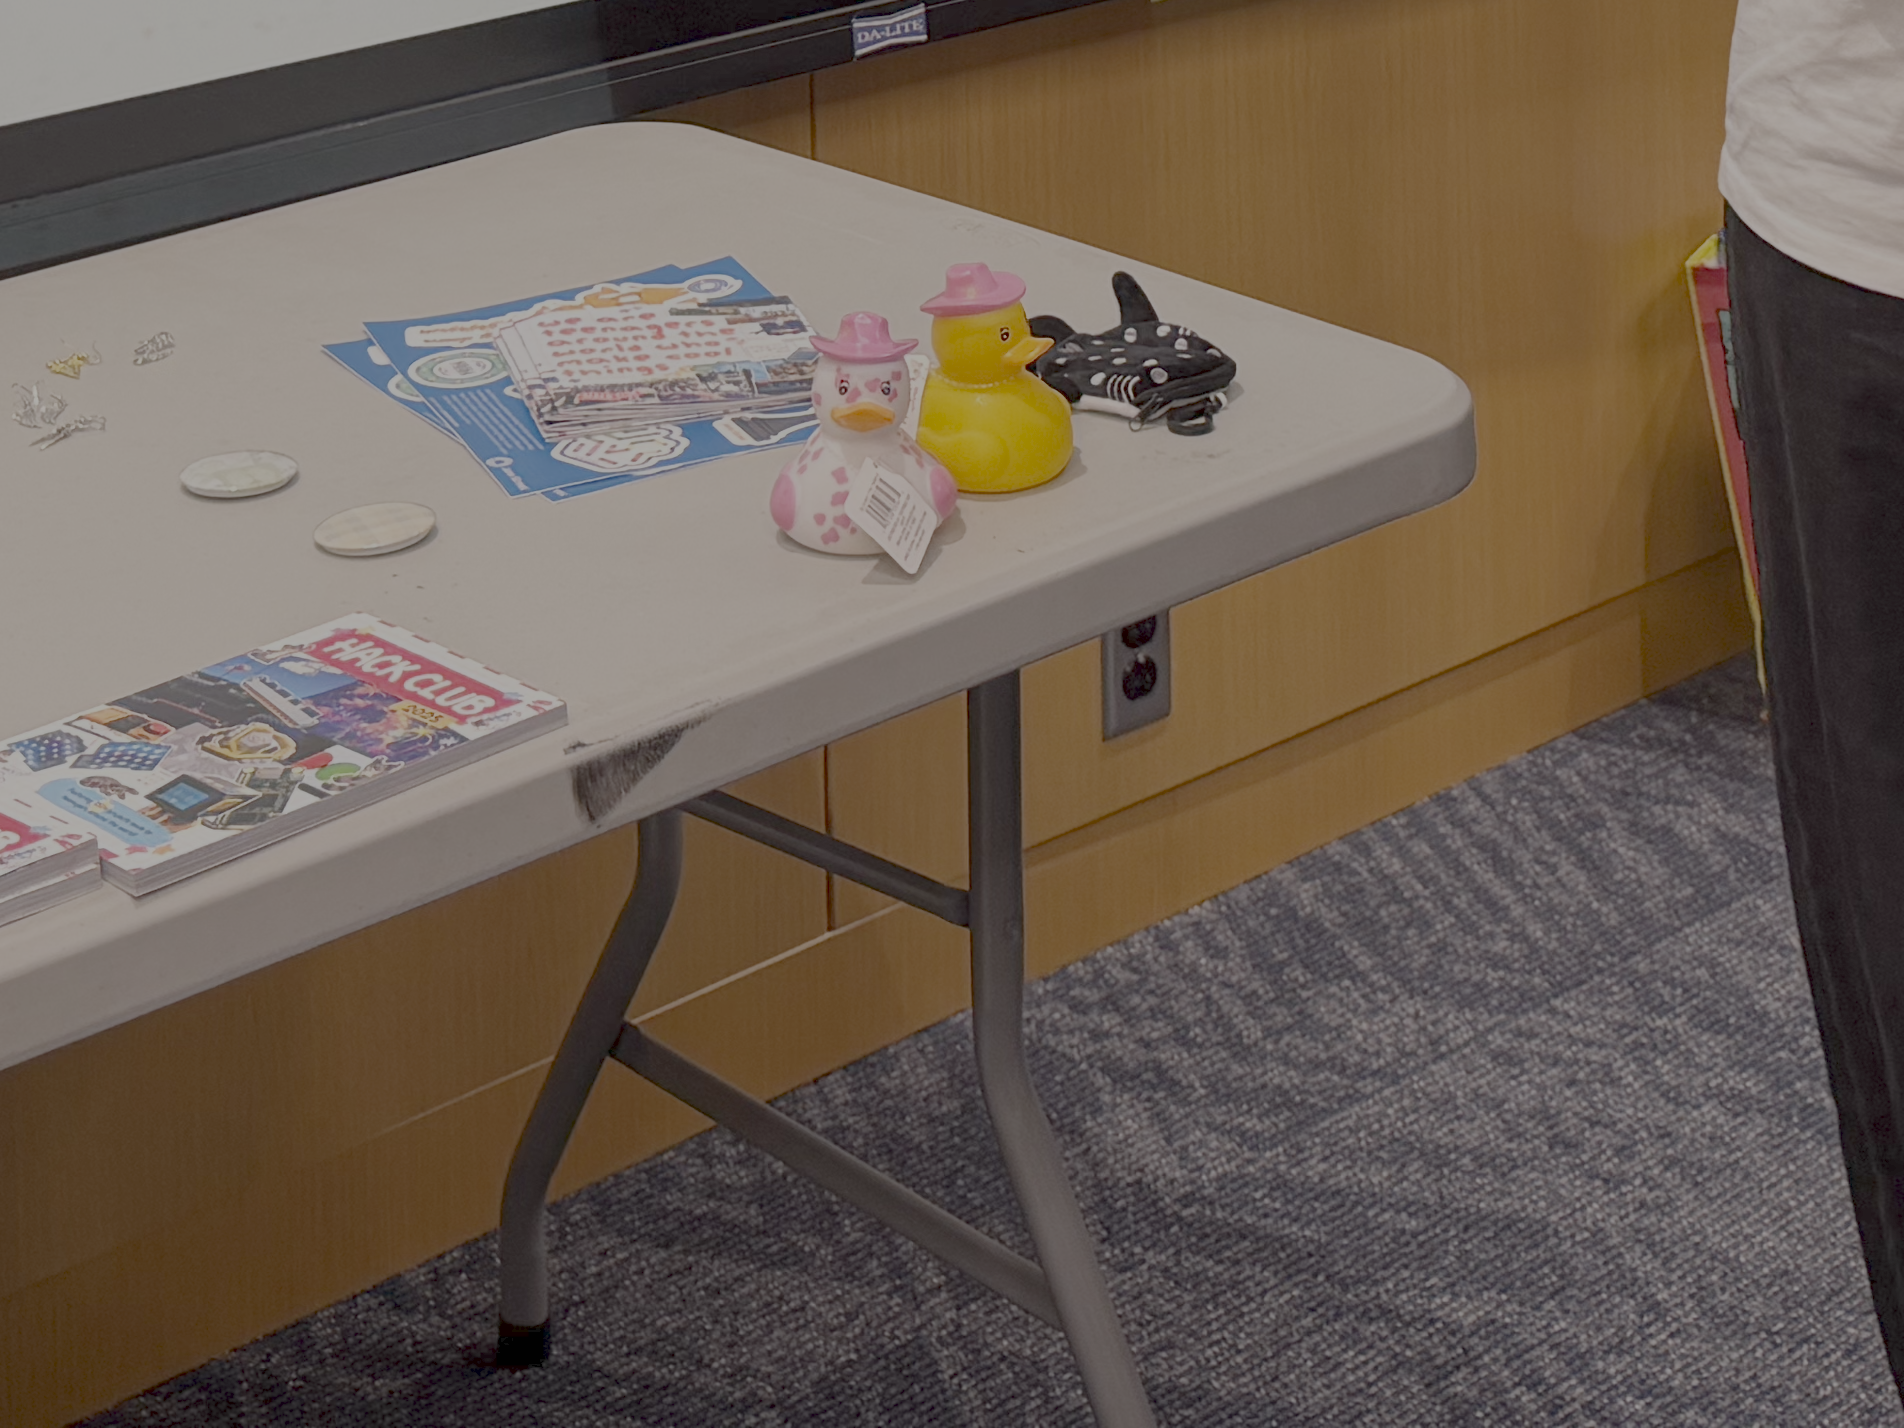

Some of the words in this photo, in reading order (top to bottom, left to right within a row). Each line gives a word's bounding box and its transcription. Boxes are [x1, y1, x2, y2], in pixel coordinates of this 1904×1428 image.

[857, 19, 924, 43] DA-LITE
[323, 638, 421, 683] HACK
[404, 673, 496, 715] CLUB
[402, 704, 446, 724] 2025
